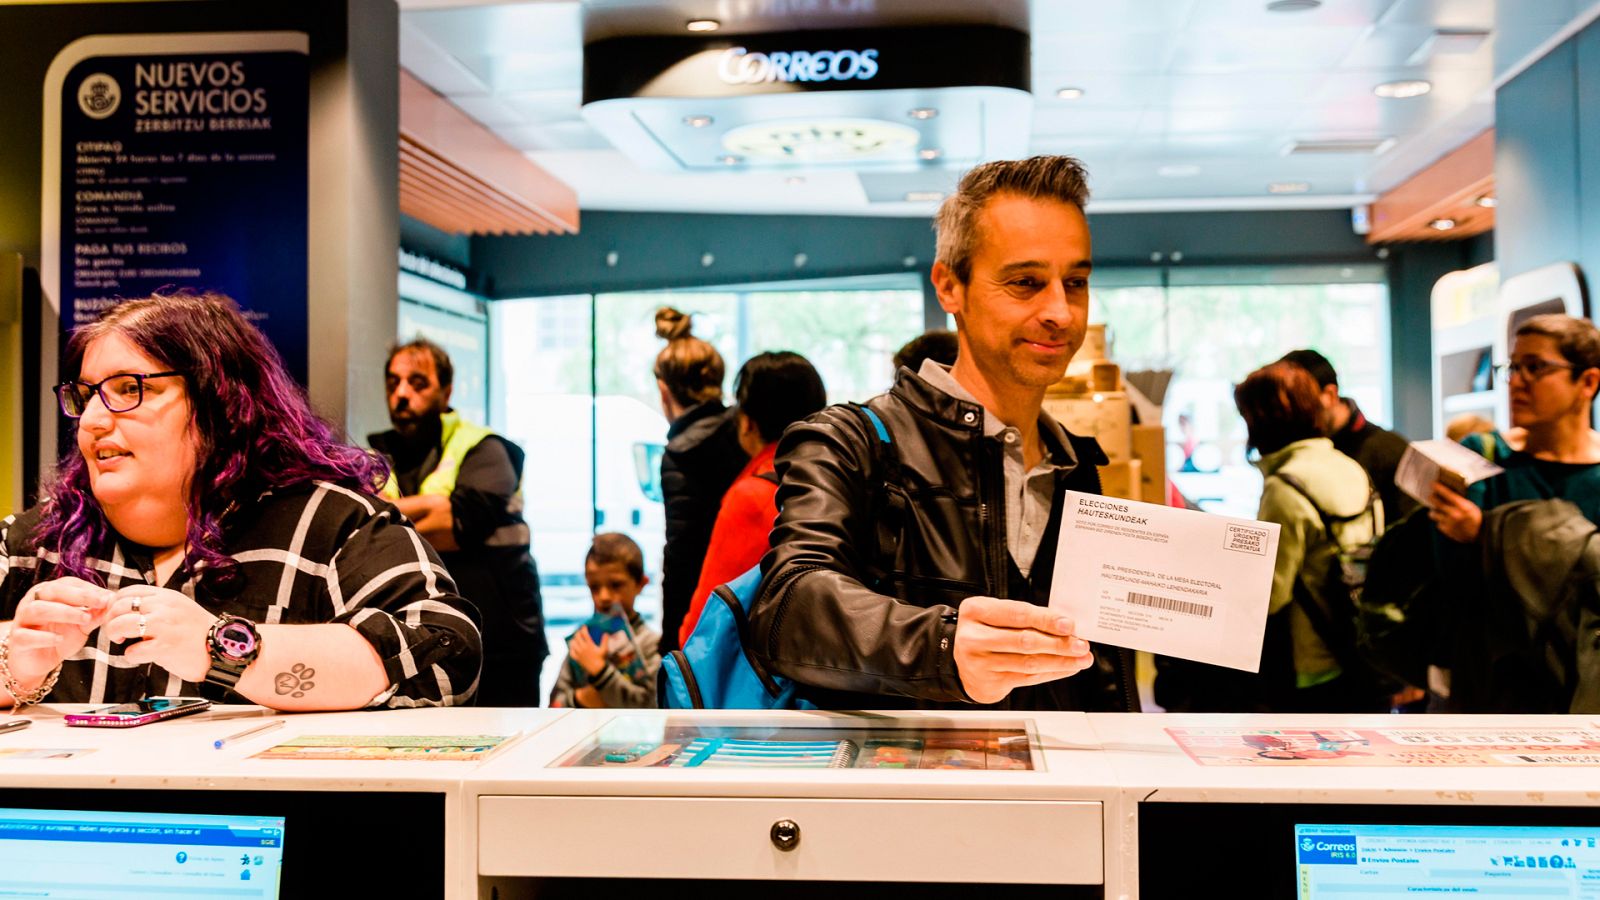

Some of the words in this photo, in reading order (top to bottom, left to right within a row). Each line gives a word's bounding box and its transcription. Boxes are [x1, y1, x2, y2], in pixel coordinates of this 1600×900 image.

[718, 46, 879, 84] CORREOS
[135, 61, 245, 87] NUEVOS
[135, 88, 267, 116] SERVICIOS
[209, 117, 272, 131] BERRIAK
[1079, 498, 1129, 512] ELECCIONES
[1077, 508, 1149, 525] HAUTESKUNDEAK
[1229, 526, 1266, 537] CERTIFICADO
[1233, 533, 1260, 541] URGENTE
[1190, 579, 1221, 590] ELECTORAL
[1316, 842, 1355, 851] Correos
